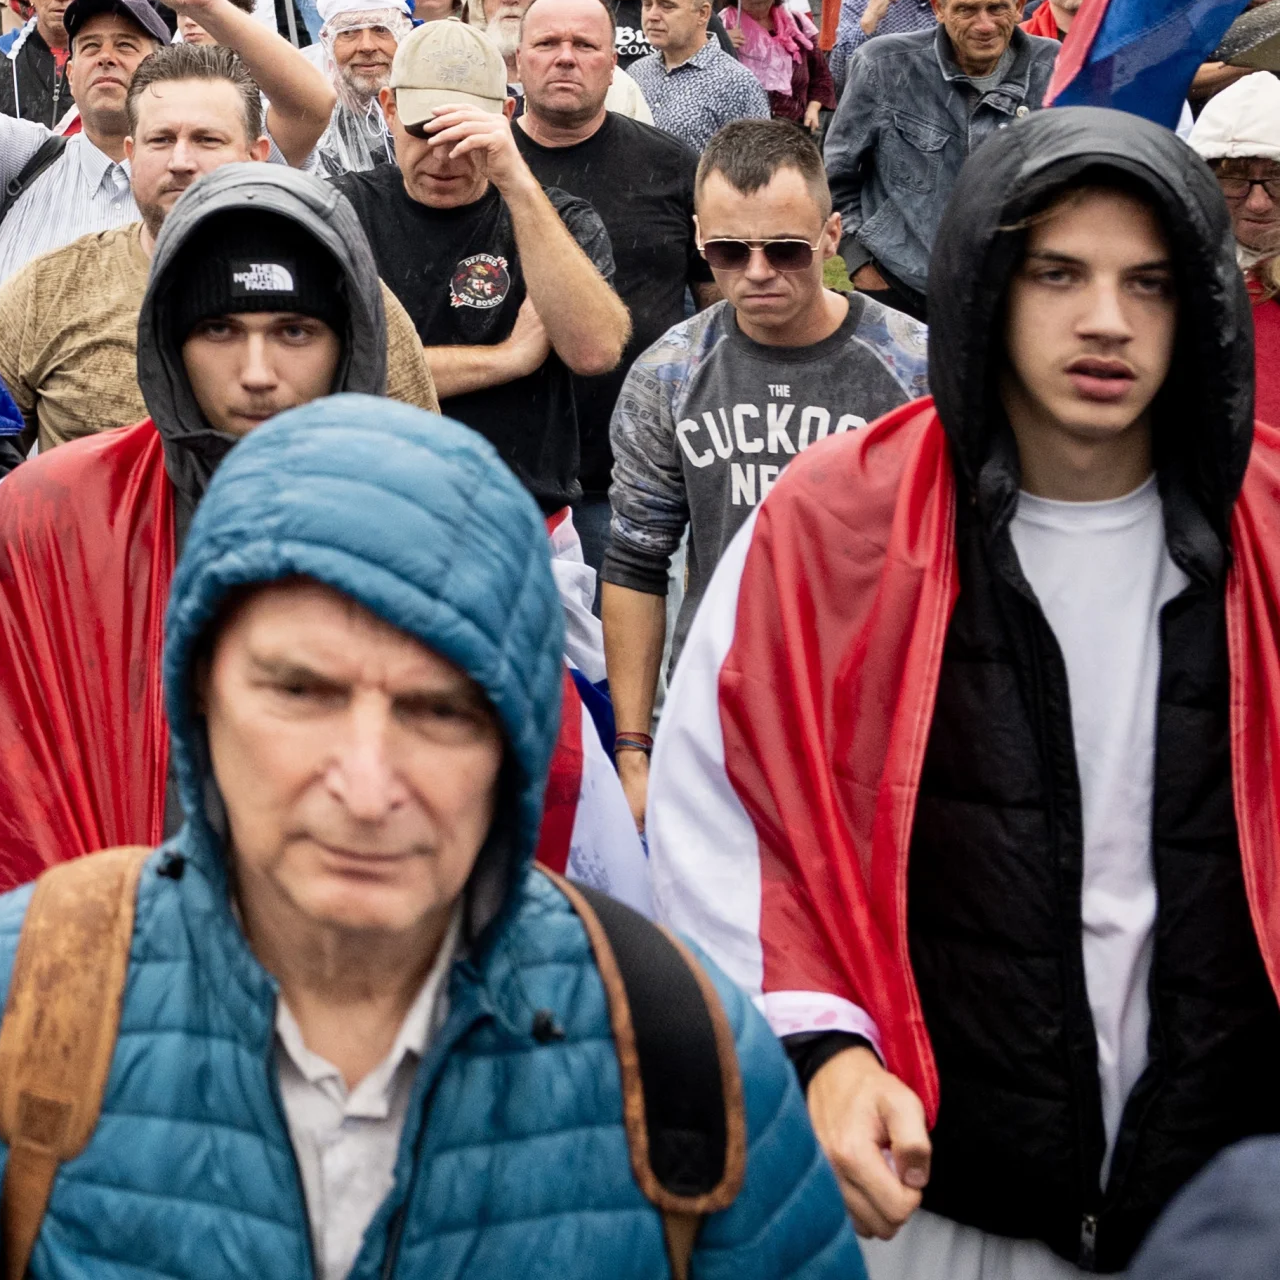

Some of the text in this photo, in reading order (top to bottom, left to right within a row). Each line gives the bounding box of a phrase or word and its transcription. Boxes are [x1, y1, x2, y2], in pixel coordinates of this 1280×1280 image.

[464, 255, 498, 267] DEFEND
[249, 263, 272, 273] THE
[233, 272, 272, 283] NORTH
[244, 281, 273, 291] FACE
[458, 292, 503, 306] DEN BOSCH
[768, 384, 790, 398] THE
